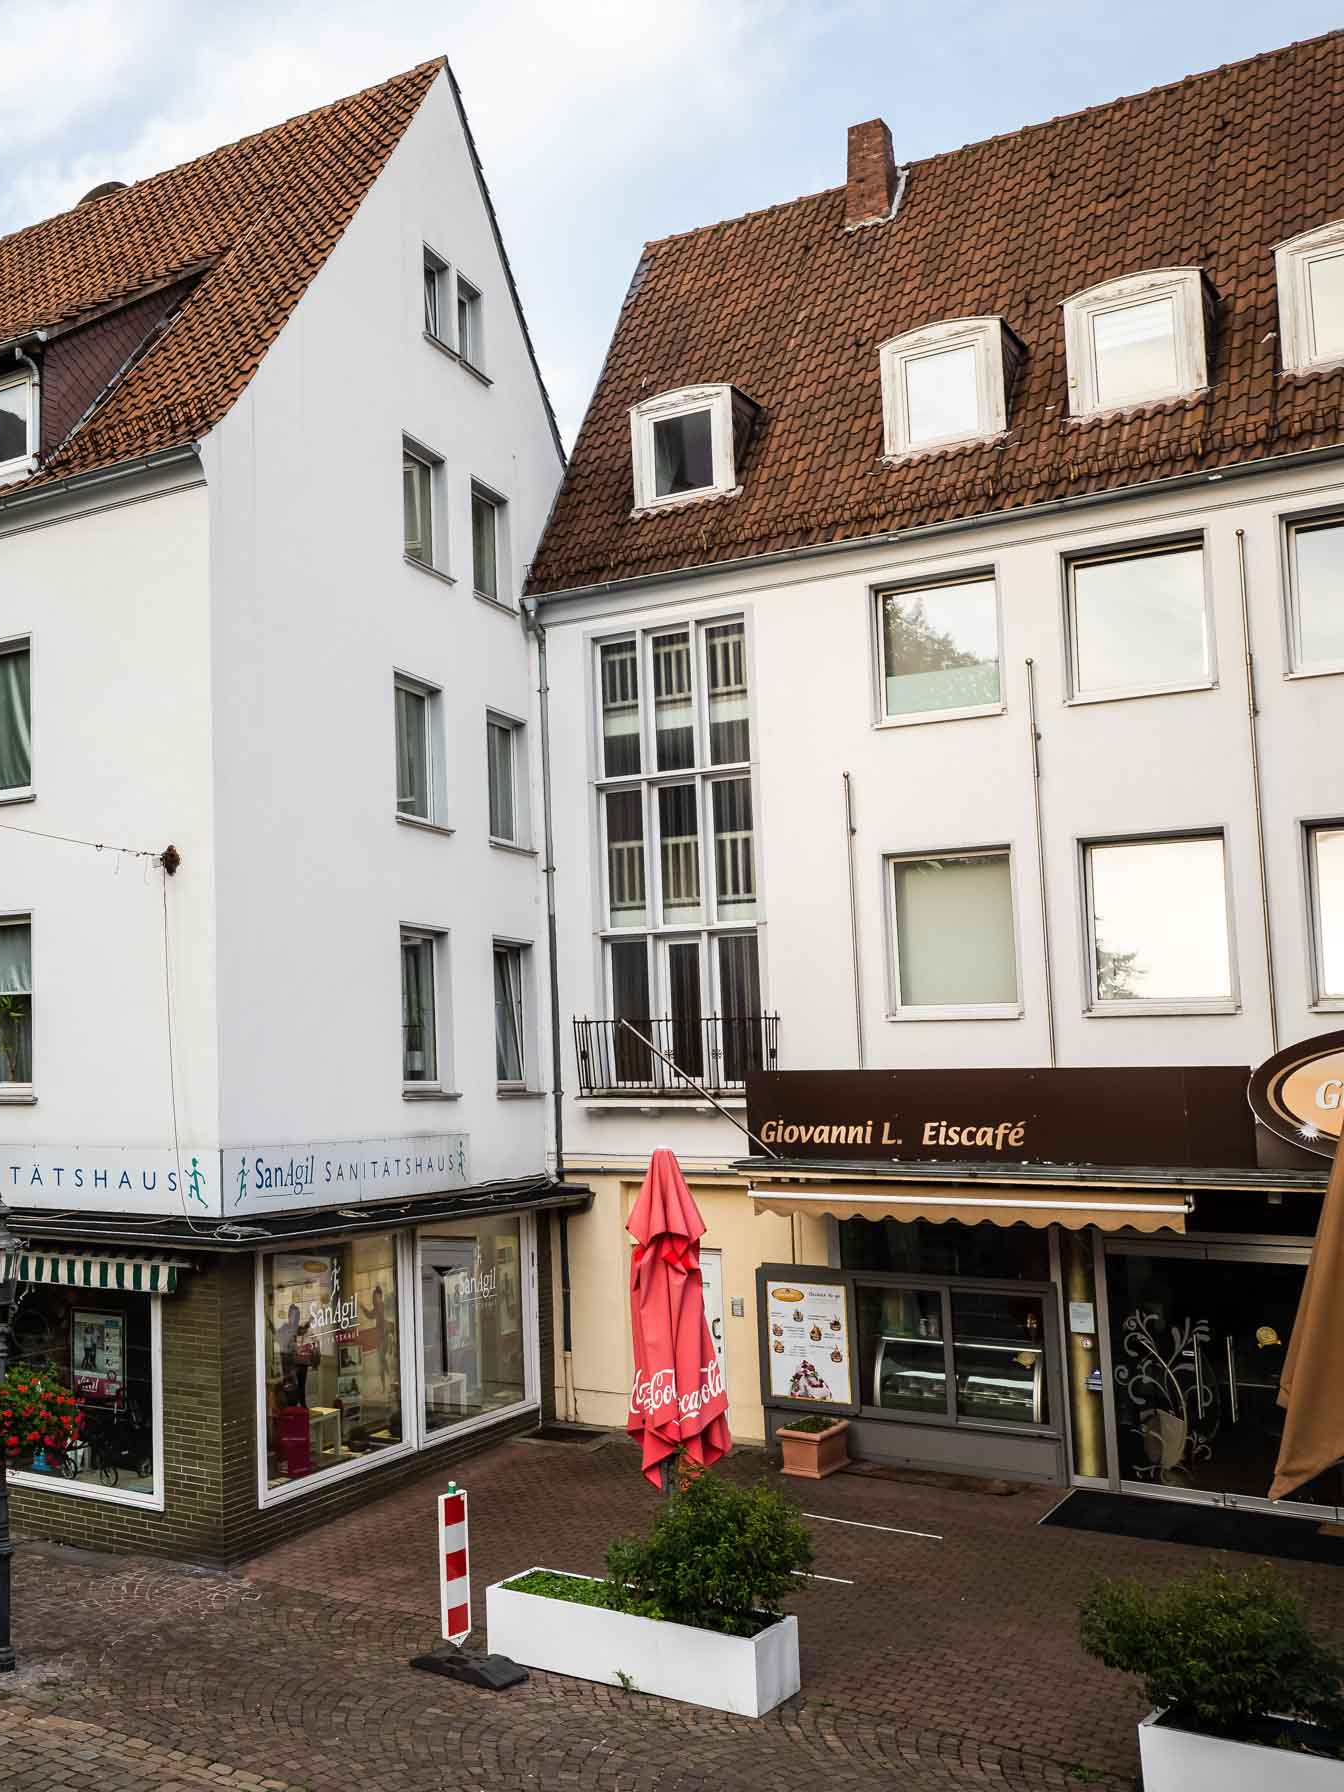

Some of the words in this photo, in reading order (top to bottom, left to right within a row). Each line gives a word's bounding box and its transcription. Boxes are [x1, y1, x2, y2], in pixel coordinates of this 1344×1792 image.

[760, 1119, 873, 1145] Giovanni
[881, 1121, 903, 1145] L.
[921, 1120, 1027, 1150] Eiscafé
[255, 1154, 314, 1195] SanAgil
[324, 1154, 455, 1182] SANITÄTSHAUS
[309, 1292, 359, 1330] SanAgil
